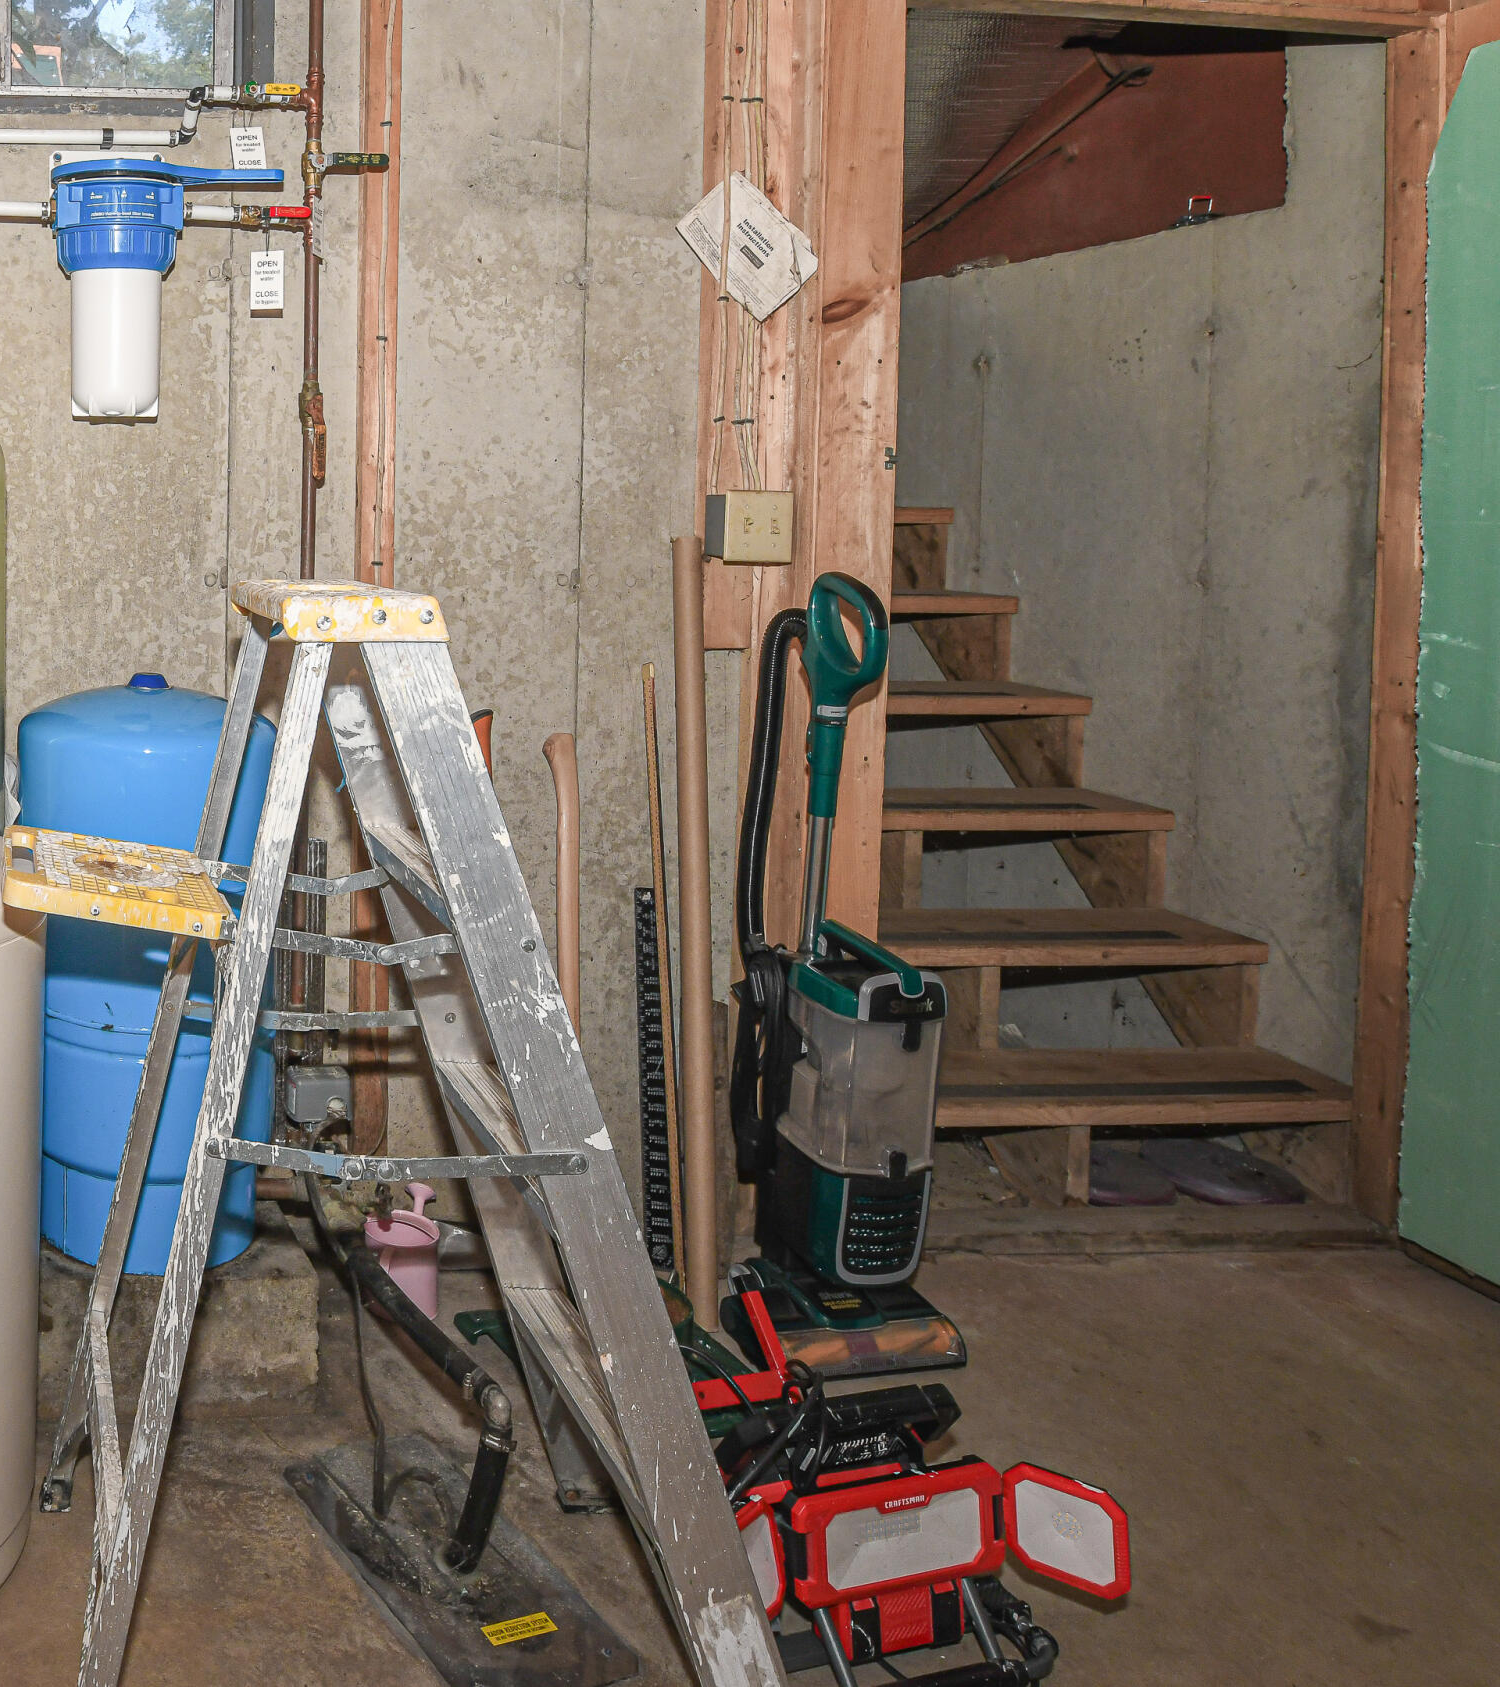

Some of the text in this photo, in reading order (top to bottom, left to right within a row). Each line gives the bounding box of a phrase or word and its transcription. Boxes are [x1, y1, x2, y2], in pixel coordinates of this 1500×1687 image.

[736, 222, 771, 258] Instructions
[743, 218, 775, 252] Installation
[256, 260, 279, 268] OPEN
[884, 1495, 926, 1508] CRAFTSMAN
